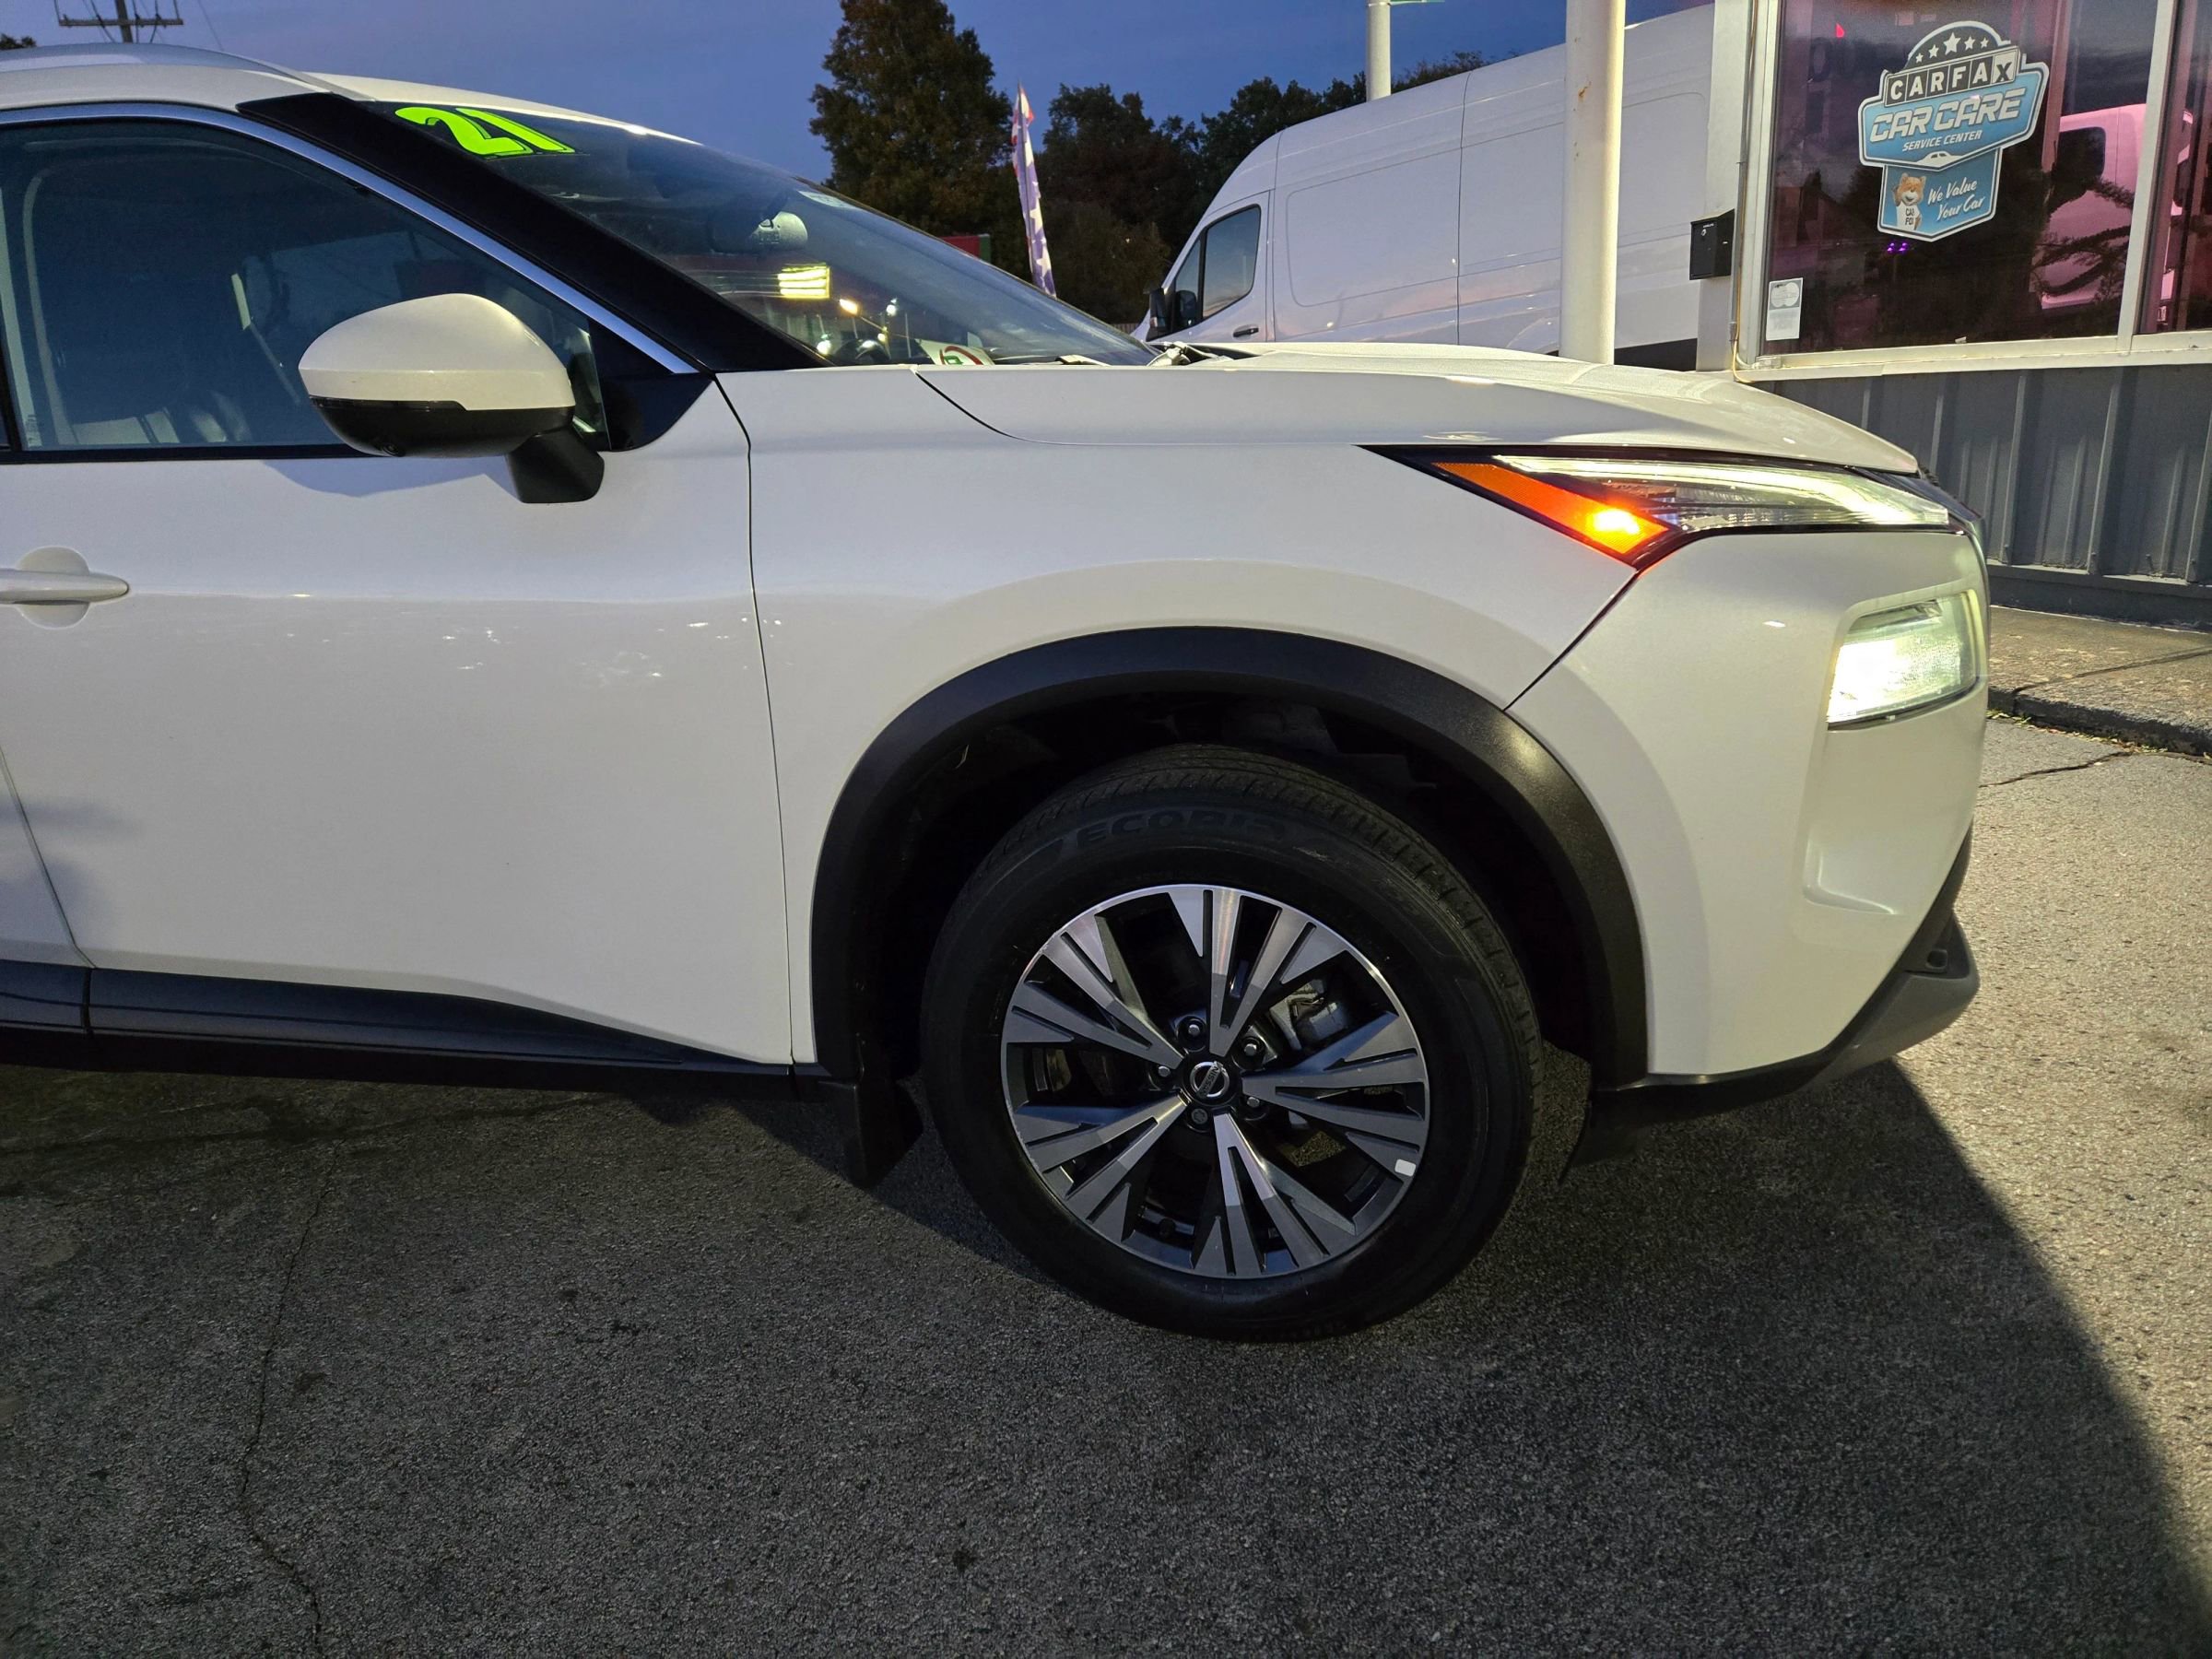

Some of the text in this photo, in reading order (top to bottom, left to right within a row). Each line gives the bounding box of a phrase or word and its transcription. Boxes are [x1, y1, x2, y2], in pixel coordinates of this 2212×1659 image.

[1889, 61, 2013, 100] CARFAX
[1870, 88, 2025, 142] CAR CARE
[394, 107, 576, 159] 21
[1902, 129, 1983, 152] SERVICE CENTER
[1927, 176, 1977, 205] We Value
[1936, 194, 1985, 222] Your Car
